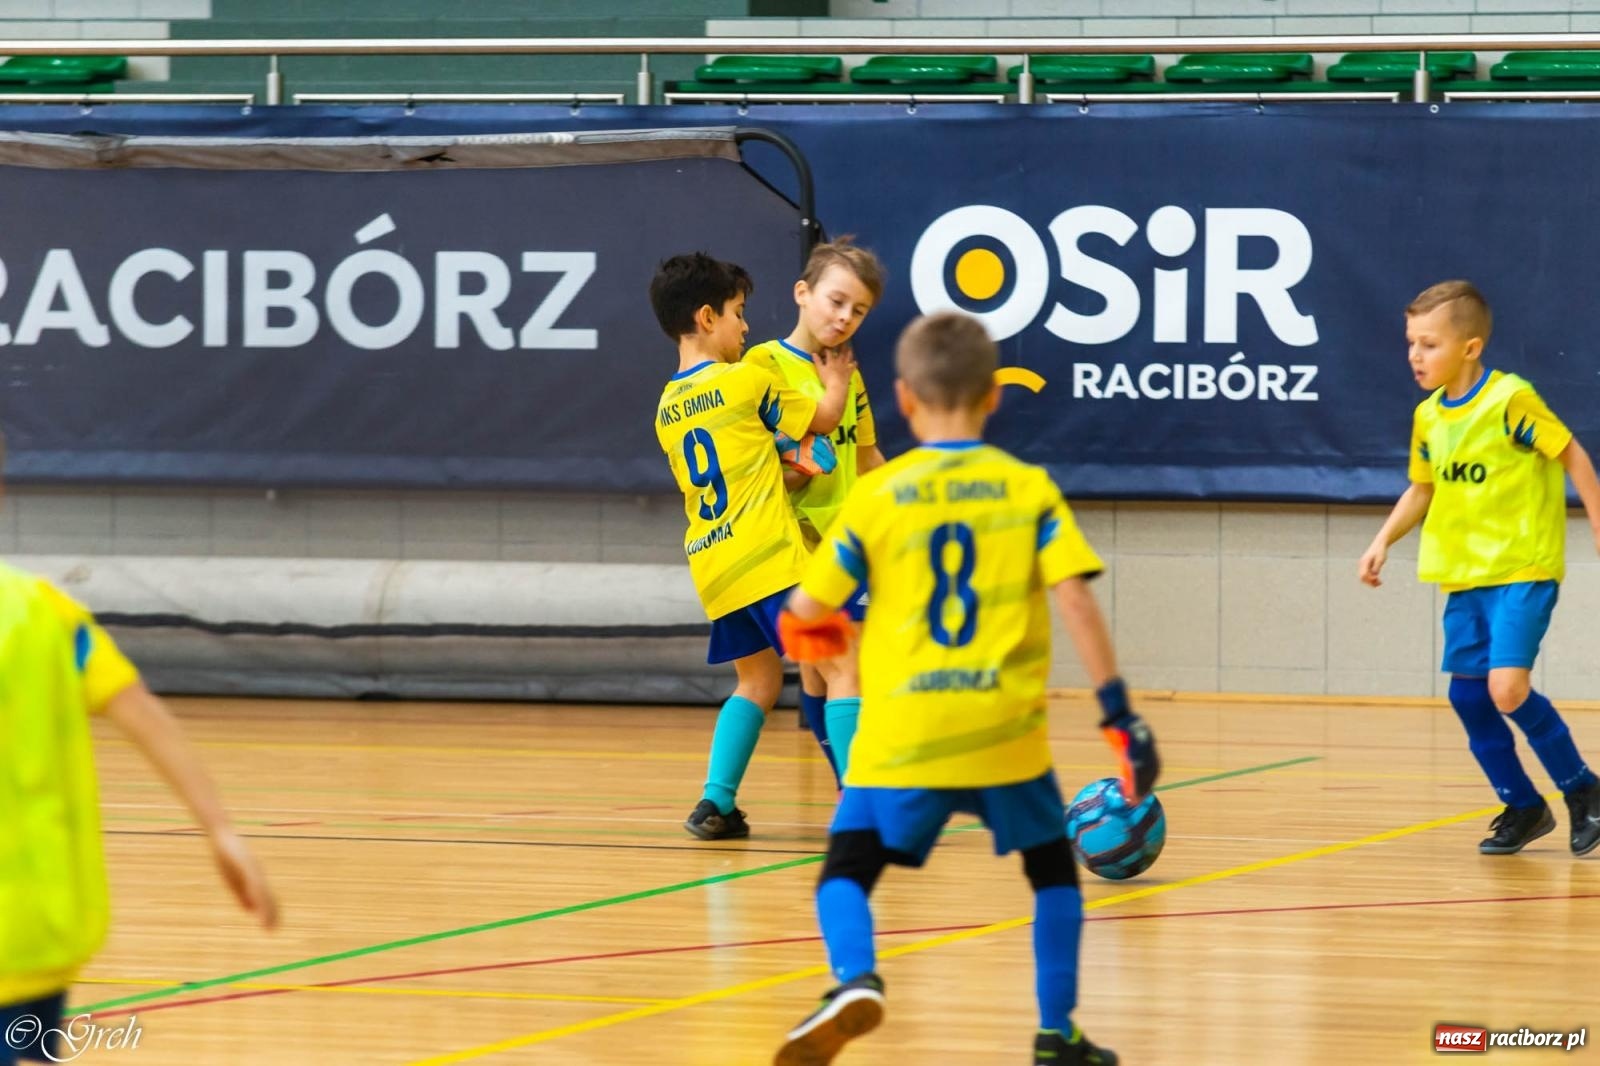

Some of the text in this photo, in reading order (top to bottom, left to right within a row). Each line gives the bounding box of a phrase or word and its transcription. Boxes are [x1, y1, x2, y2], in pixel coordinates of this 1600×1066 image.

[0, 212, 599, 350] ACIBÓRZ
[683, 389, 725, 418] GMINA
[1072, 352, 1319, 400] RACIBÓRZ
[683, 427, 728, 521] 9
[929, 522, 978, 648] 8
